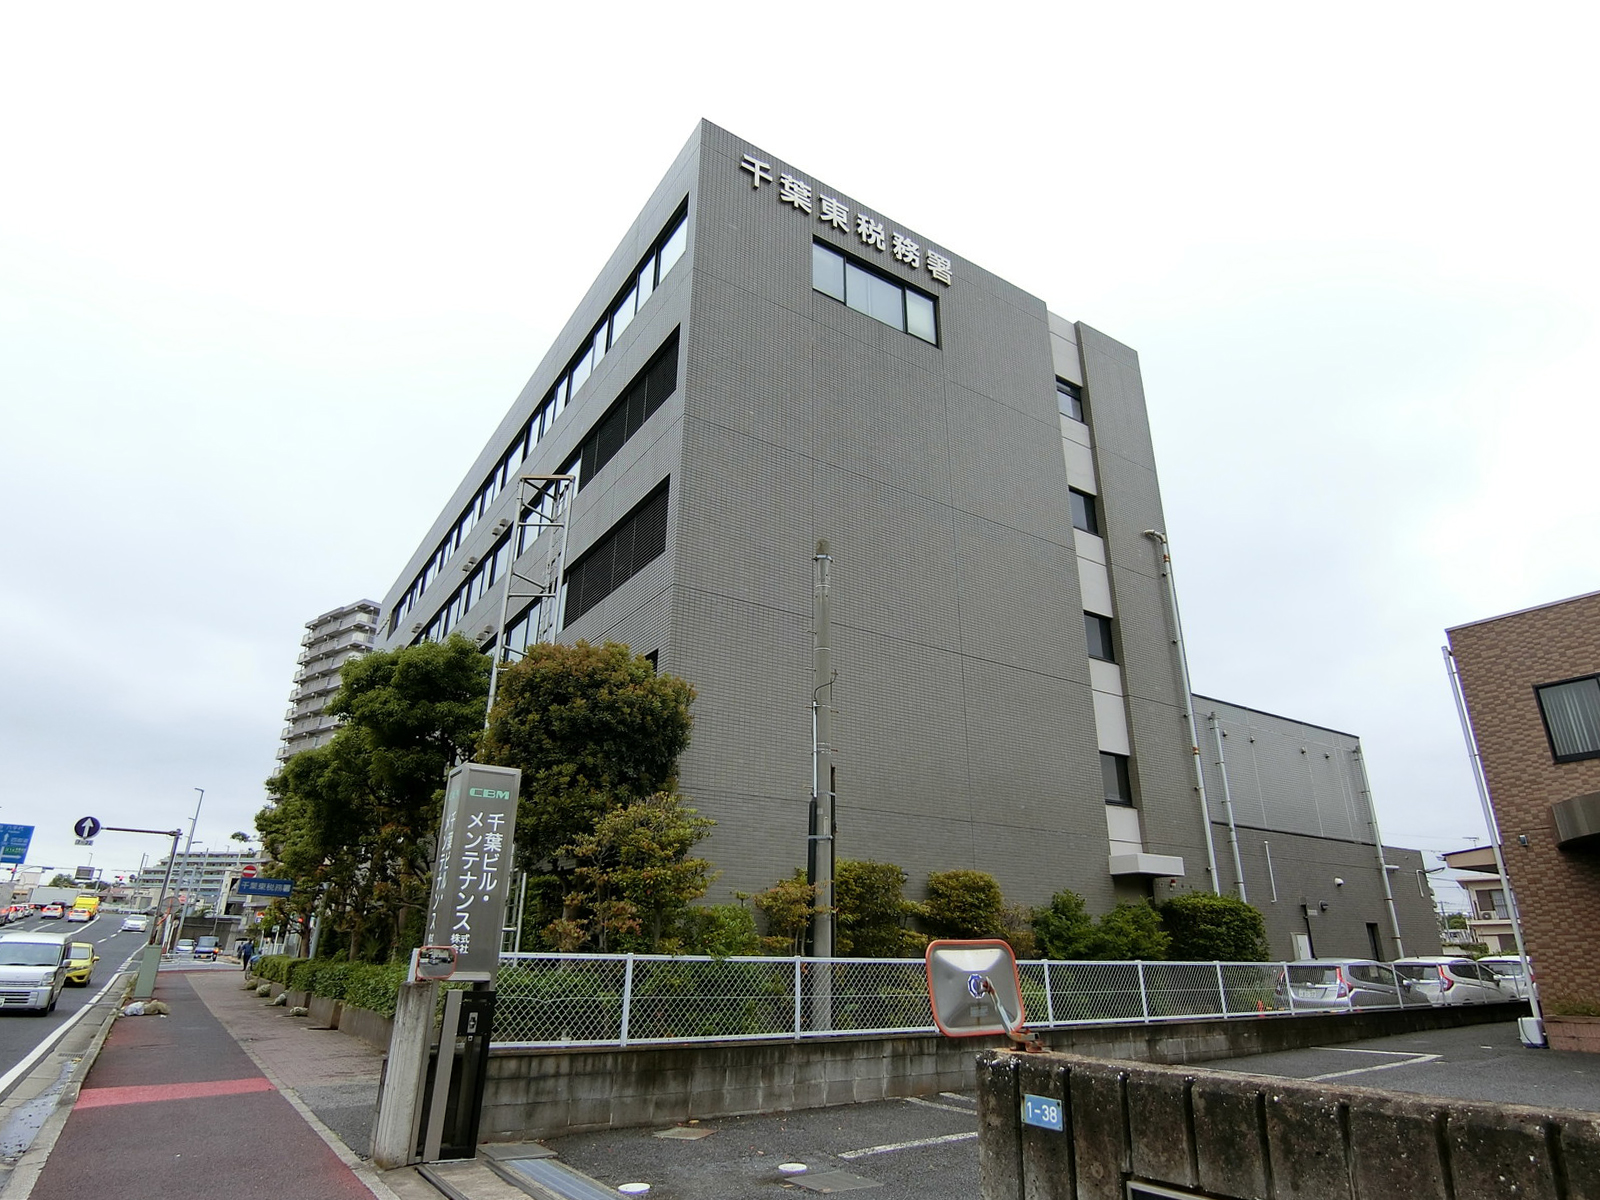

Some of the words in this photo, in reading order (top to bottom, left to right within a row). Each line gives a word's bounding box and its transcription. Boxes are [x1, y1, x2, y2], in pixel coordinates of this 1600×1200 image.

[740, 153, 953, 287] 千葉東税務署
[469, 787, 510, 800] CBM
[453, 812, 483, 931] メンテナンス
[241, 881, 291, 892] 千葉東税務署
[1026, 1101, 1058, 1123] 1-38
